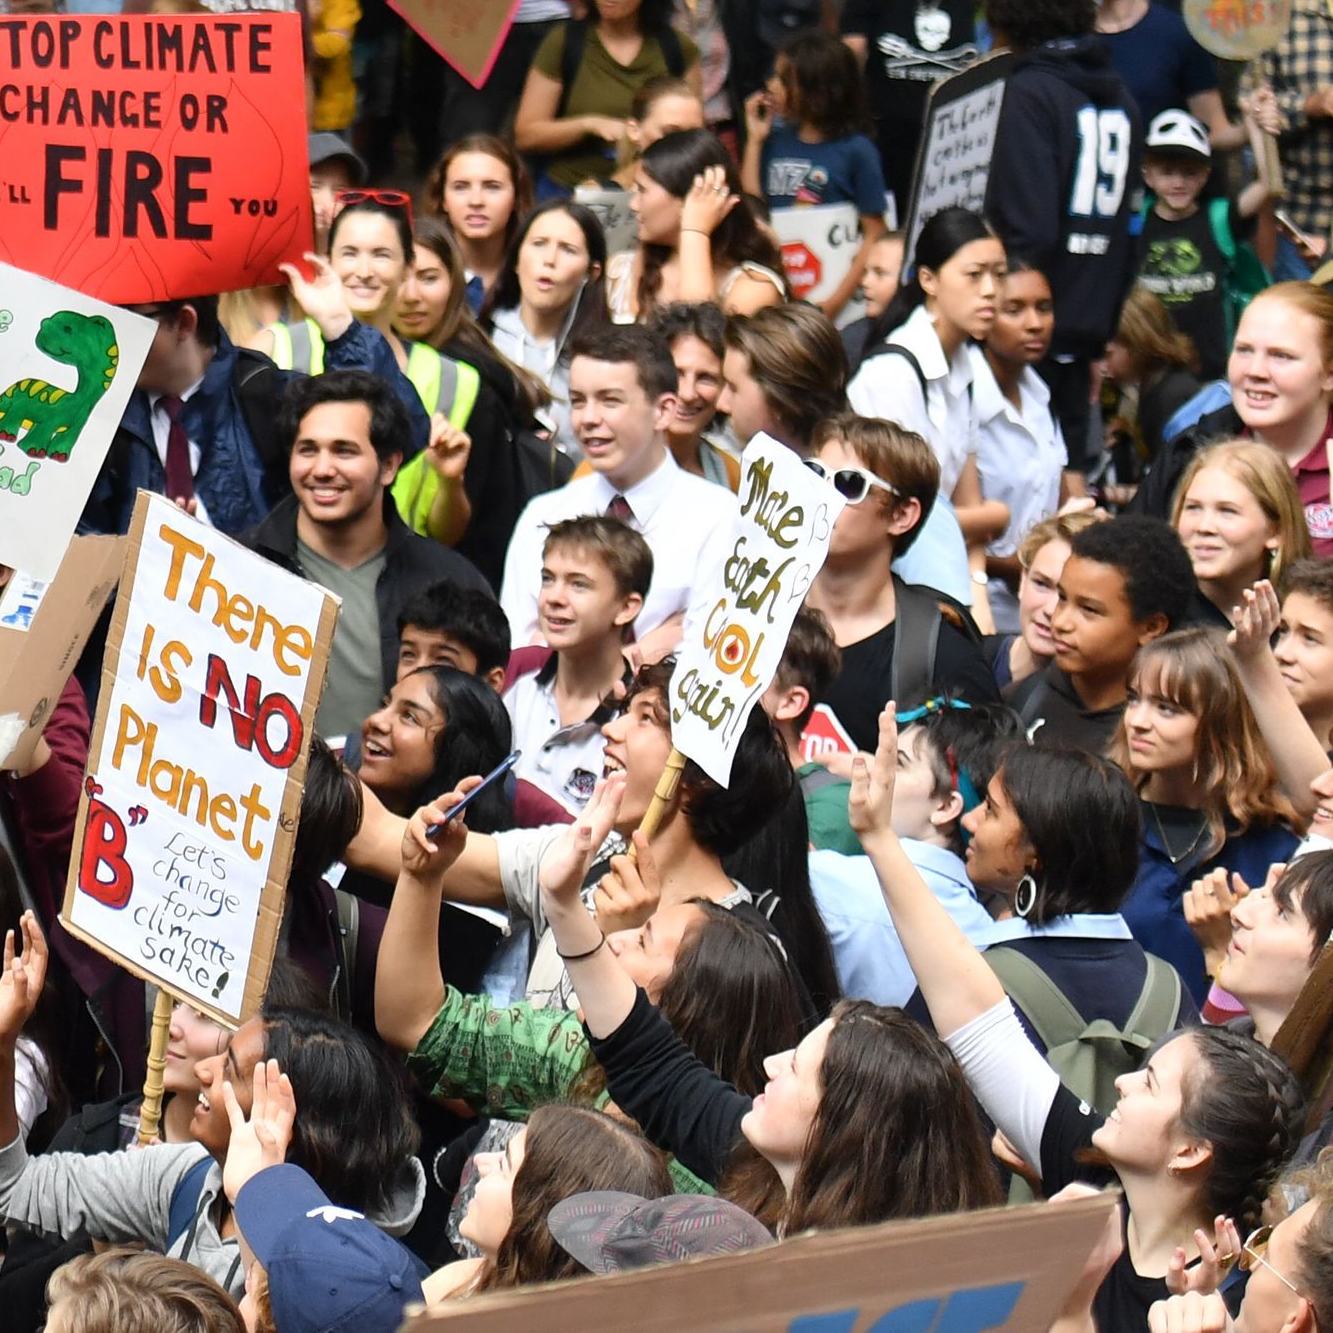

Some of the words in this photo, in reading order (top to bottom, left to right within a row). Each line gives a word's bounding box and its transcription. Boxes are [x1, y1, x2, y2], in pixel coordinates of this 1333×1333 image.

[93, 20, 273, 74] CLIMATE
[179, 93, 229, 134] OR
[44, 143, 214, 242] FIRE
[228, 197, 279, 217] YOU
[1069, 103, 1132, 218] 19
[159, 523, 314, 678] There
[199, 652, 305, 770] NO
[800, 731, 839, 763] OP
[111, 703, 272, 862] Planet
[151, 857, 241, 918] change
[163, 831, 228, 881] Let's
[133, 903, 236, 970] climate
[162, 890, 202, 923] for
